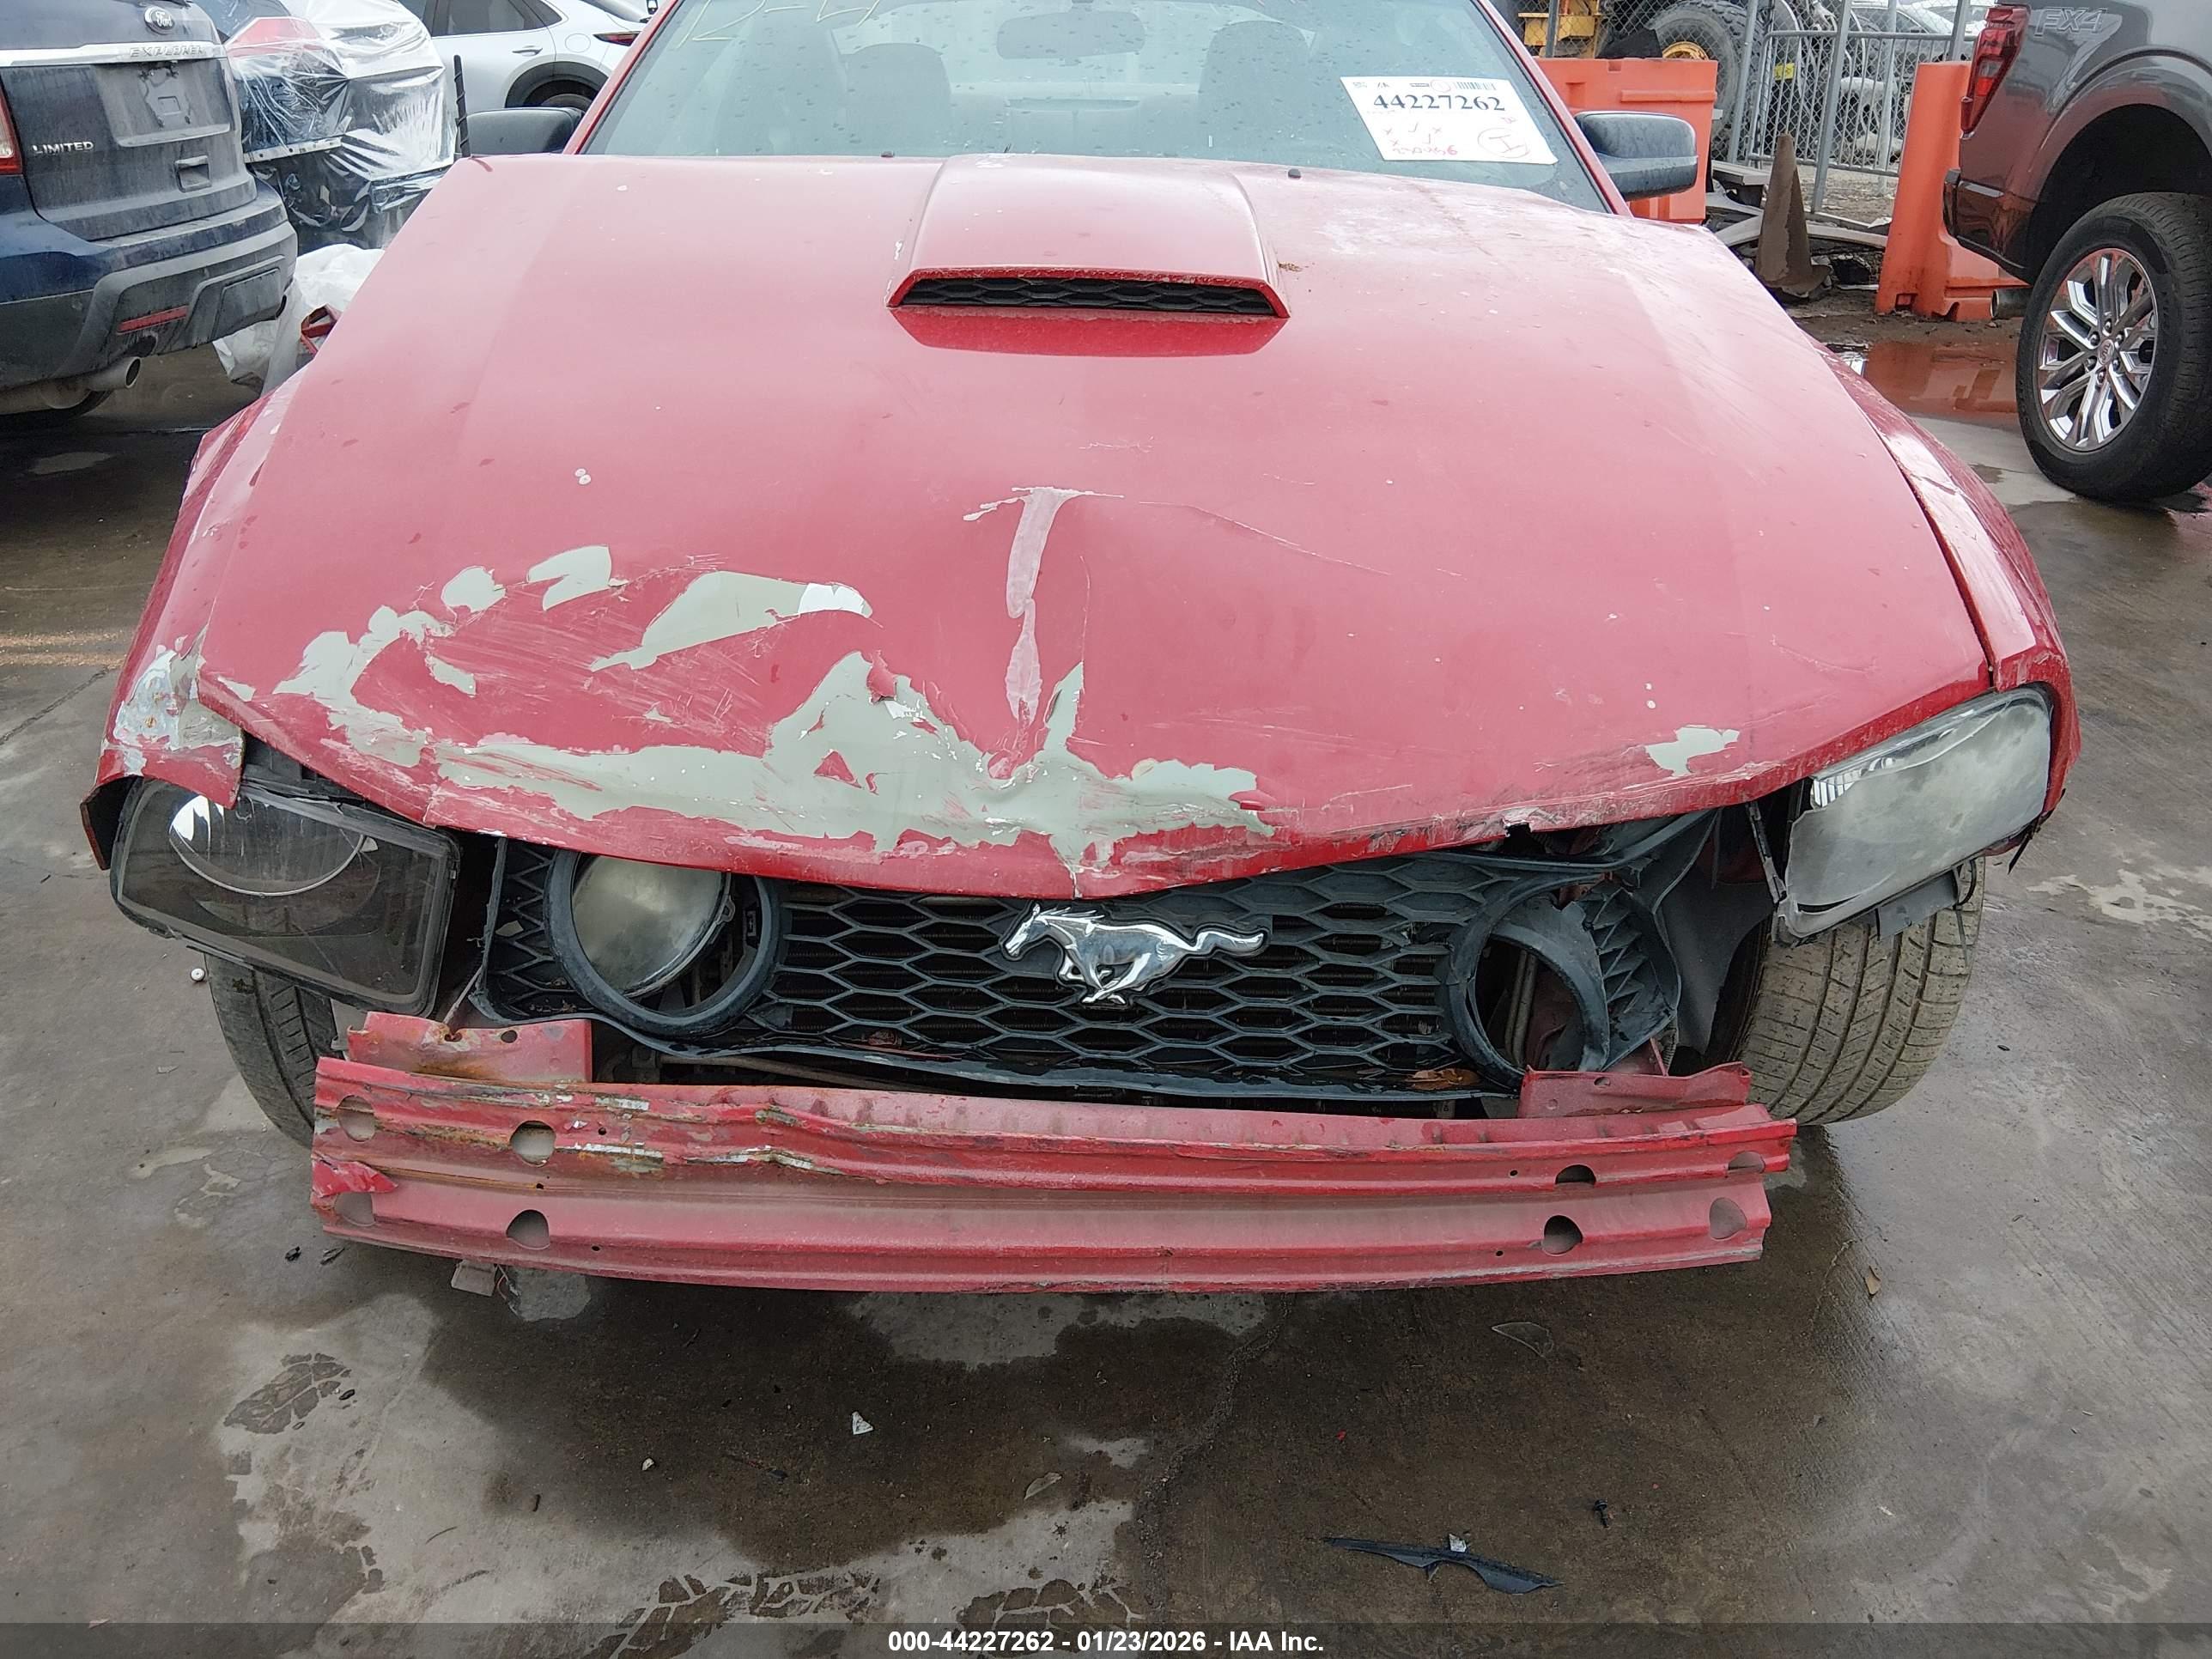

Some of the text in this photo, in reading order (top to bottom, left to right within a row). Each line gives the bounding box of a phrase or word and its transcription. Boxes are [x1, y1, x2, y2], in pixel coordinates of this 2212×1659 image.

[155, 11, 173, 27] Ford
[2033, 7, 2109, 38] FX4
[131, 46, 206, 58] EXPLORER
[1374, 94, 1505, 111] 44227262
[32, 141, 94, 155] LIMITED
